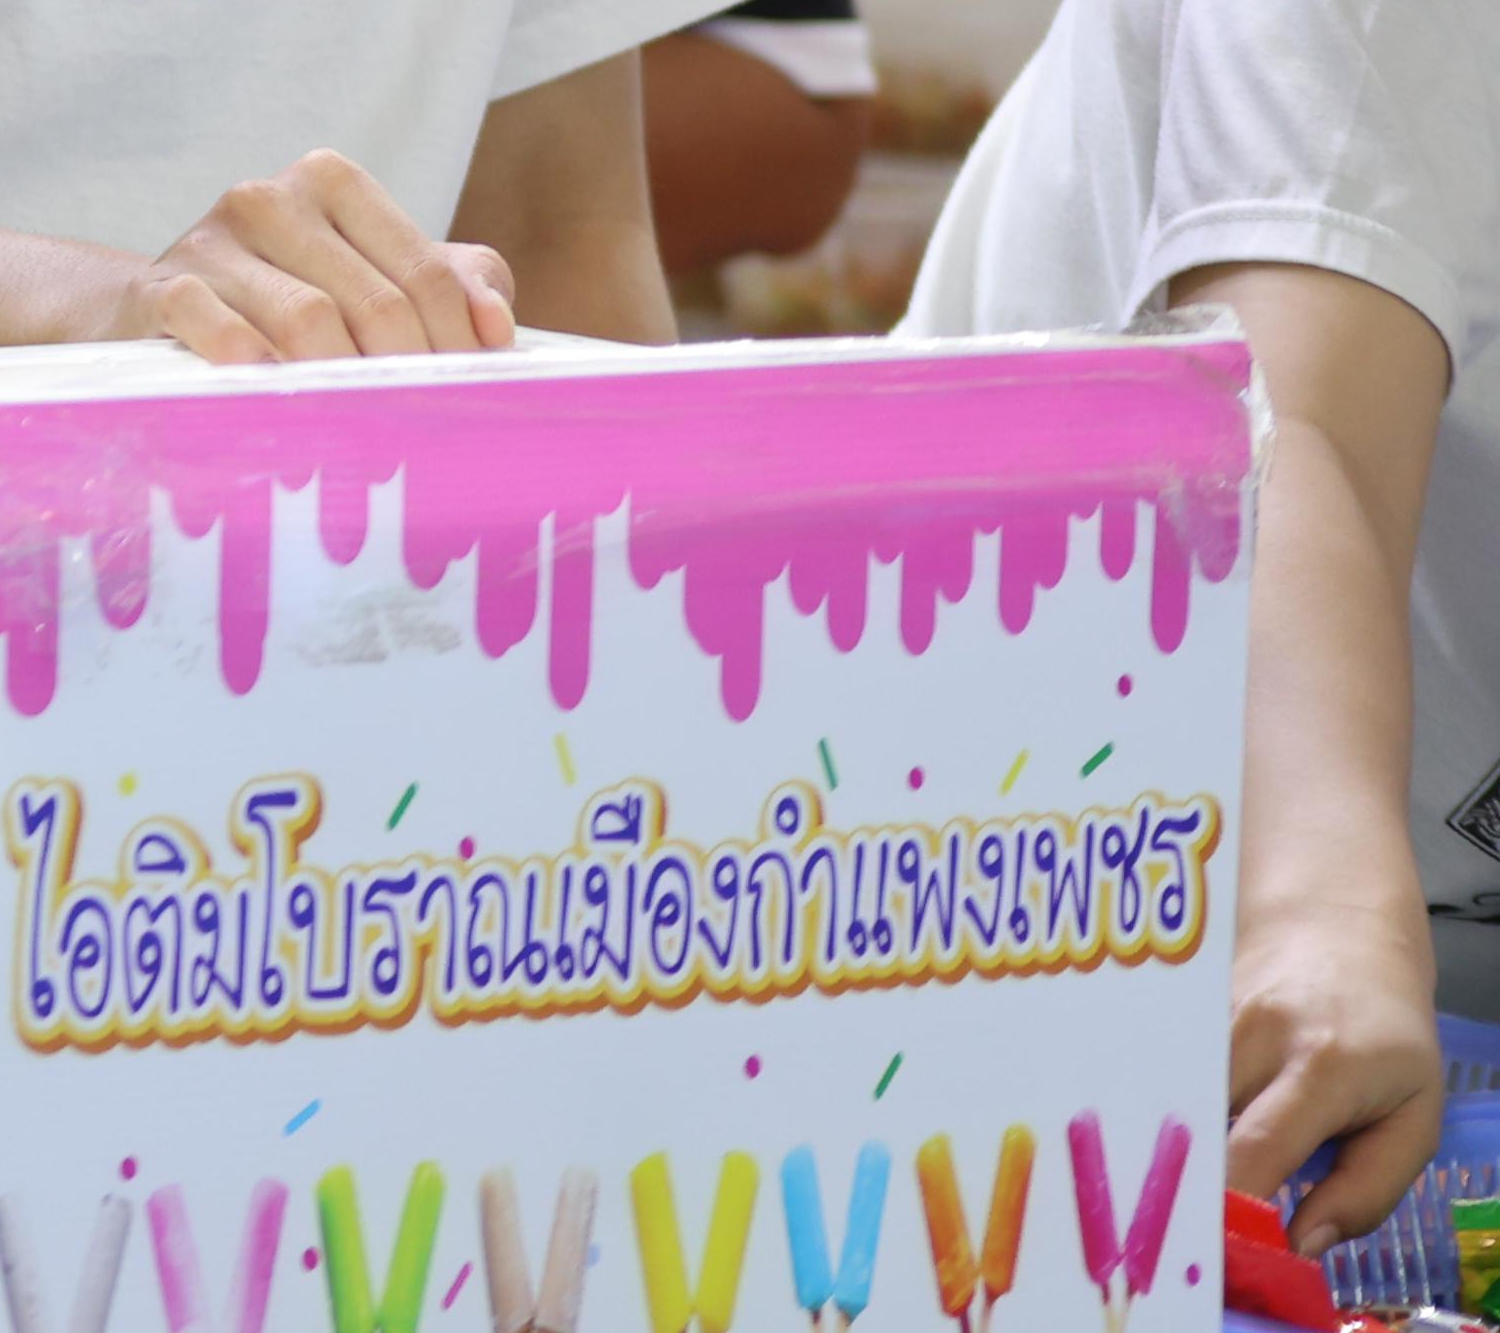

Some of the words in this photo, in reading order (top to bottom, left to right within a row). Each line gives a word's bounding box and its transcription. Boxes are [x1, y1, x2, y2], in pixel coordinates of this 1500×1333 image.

[17, 788, 1202, 1020] ไอติมโบราณเมืองกำแพงเพชร
